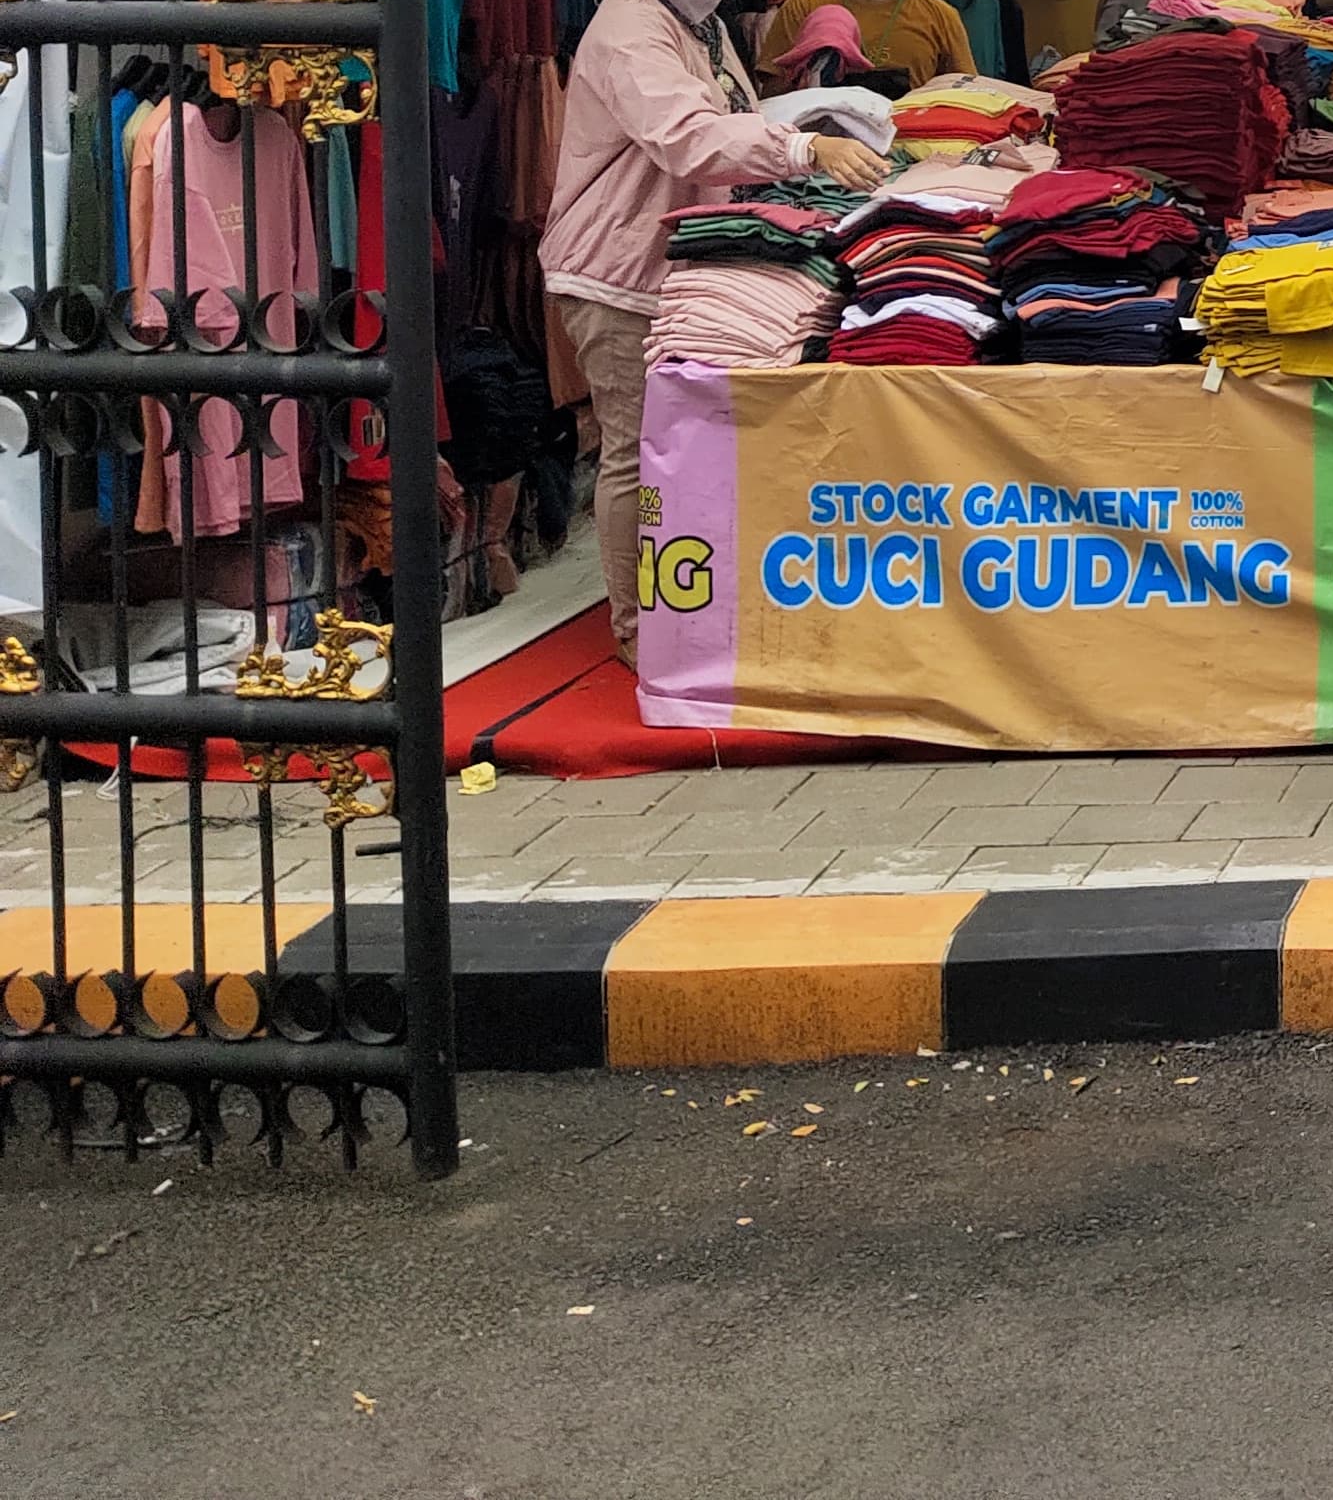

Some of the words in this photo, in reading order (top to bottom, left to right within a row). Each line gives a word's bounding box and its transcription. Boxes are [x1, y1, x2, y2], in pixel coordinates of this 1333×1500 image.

[808, 482, 953, 529] STOCK
[962, 482, 1179, 534] GARMENT
[1189, 488, 1245, 514] 100%
[1189, 513, 1246, 531] COTTON
[761, 534, 943, 611] CUCI
[961, 535, 1293, 613] GUDANG
